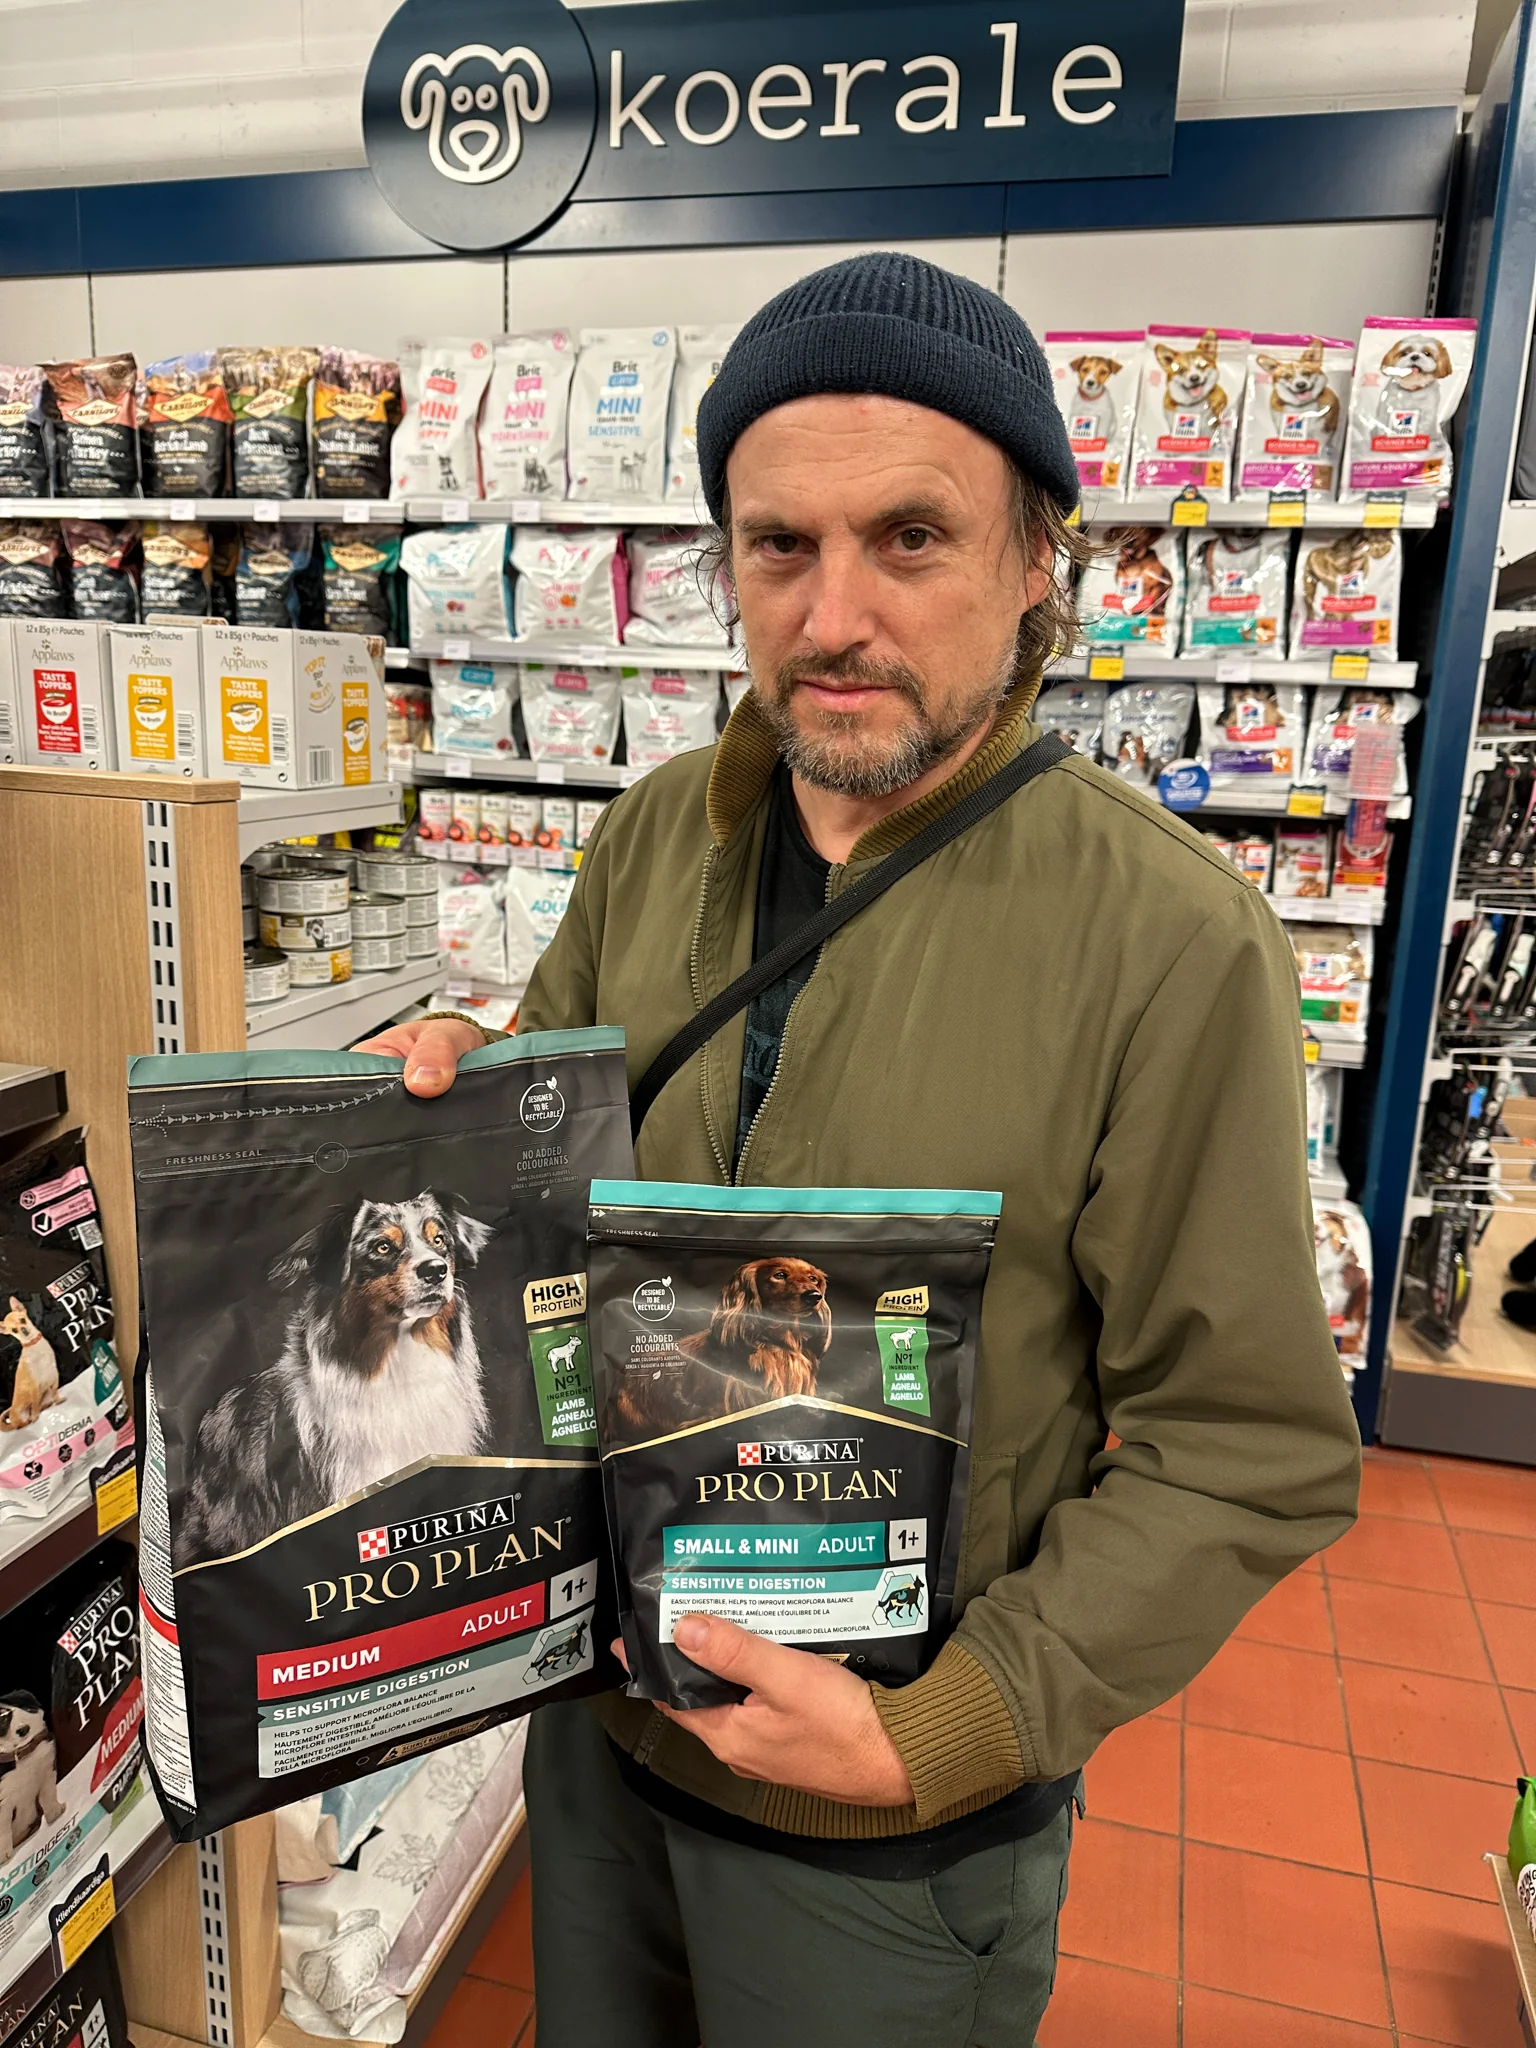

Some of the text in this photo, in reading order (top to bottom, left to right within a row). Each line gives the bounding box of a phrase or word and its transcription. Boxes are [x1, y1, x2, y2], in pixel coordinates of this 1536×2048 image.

[607, 21, 1124, 149] koerale
[161, 399, 208, 412] CARNILOVE
[418, 401, 458, 421] MINI
[504, 402, 545, 421] MINI
[596, 397, 642, 415] MINI
[39, 625, 51, 636] 85g
[59, 626, 85, 636] Pouches
[157, 631, 183, 641] Pouches
[215, 631, 224, 639] 12
[229, 632, 242, 642] 85g
[252, 632, 279, 643] Pouches
[32, 649, 75, 664] Applaws
[129, 654, 172, 669] Applaws
[221, 656, 268, 671] Applaws
[41, 673, 66, 681] TASTE
[137, 678, 162, 687] TASTE
[464, 670, 490, 682] care
[557, 676, 584, 688] care
[38, 681, 73, 690] TOPPERS
[132, 686, 167, 696] TOPPERS
[230, 680, 258, 690] TASTE
[226, 688, 263, 700] TOPPERS
[531, 899, 567, 915] ADU
[527, 1093, 553, 1104] DESIGNED
[533, 1102, 549, 1112] TO BE
[165, 1149, 263, 1166] FRESHNESS SEAL
[522, 1145, 562, 1161] NO ADDED
[516, 1155, 570, 1172] COLOURANTS
[531, 1282, 581, 1303] HIGH
[641, 1289, 665, 1297] DESIGNED
[884, 1292, 923, 1306] HIGH
[635, 1334, 673, 1344] NO ADDED
[630, 1342, 680, 1354] COLOURANTS
[895, 1373, 915, 1381] LAMB
[547, 1386, 592, 1401] INGREDIENT
[891, 1382, 921, 1391] AGNEAU
[889, 1392, 924, 1401] AGNELLO
[556, 1398, 586, 1413] LAMB
[551, 1409, 594, 1426] AGNEAU
[21, 1415, 93, 1459] OPTIDERMA
[551, 1421, 597, 1439] AGNELLO
[763, 1441, 856, 1463] PURINA
[694, 1467, 898, 1504] PRO PLAN
[391, 1503, 510, 1551] PURINA
[673, 1535, 877, 1555] SMALL & MINI ADULT
[896, 1529, 920, 1550] 1+
[302, 1518, 566, 1623] PRO PLAN
[560, 1576, 589, 1603] 1+
[671, 1576, 827, 1591] SENSITIVE DIGESTION
[670, 1598, 691, 1606] EASILY
[692, 1598, 728, 1606] DIGESTIBLE,
[728, 1598, 748, 1606] HELPS
[758, 1598, 786, 1606] IMPROVE
[786, 1598, 826, 1606] MICROFLORA
[72, 1586, 123, 1639] PURINA
[709, 1609, 744, 1617] DIGESTIBLE,
[745, 1607, 777, 1617] AMÉLIORE
[812, 1608, 822, 1616] DE
[822, 1608, 830, 1616] LA
[774, 1627, 813, 1636] L'EQUILIBRIO
[813, 1627, 832, 1635] DELLA
[832, 1625, 870, 1633] MICROFLORA
[73, 1604, 134, 1686] PRO
[270, 1599, 533, 1686] MEDIUM ADULT
[272, 1658, 471, 1722] SENSITIVE DIGESTION
[274, 1689, 438, 1739] HELPS TO SUPPORT MICROFLORA BALANCE
[274, 1686, 476, 1749] HAUTEMENT DIGESTIBLE, AMÉLIORE L'ÉQUILIBRE DE LA
[274, 1749, 324, 1767] FACILMENTE
[370, 1721, 407, 1739] MIGLIORA
[407, 1706, 453, 1726] L'EQUILIBRIO
[274, 1723, 376, 1756] MICROFLORE INTESTINALE
[274, 1745, 352, 1774] DELLA MICROFLORA
[55, 1870, 106, 1927] Kliendikaardiga
